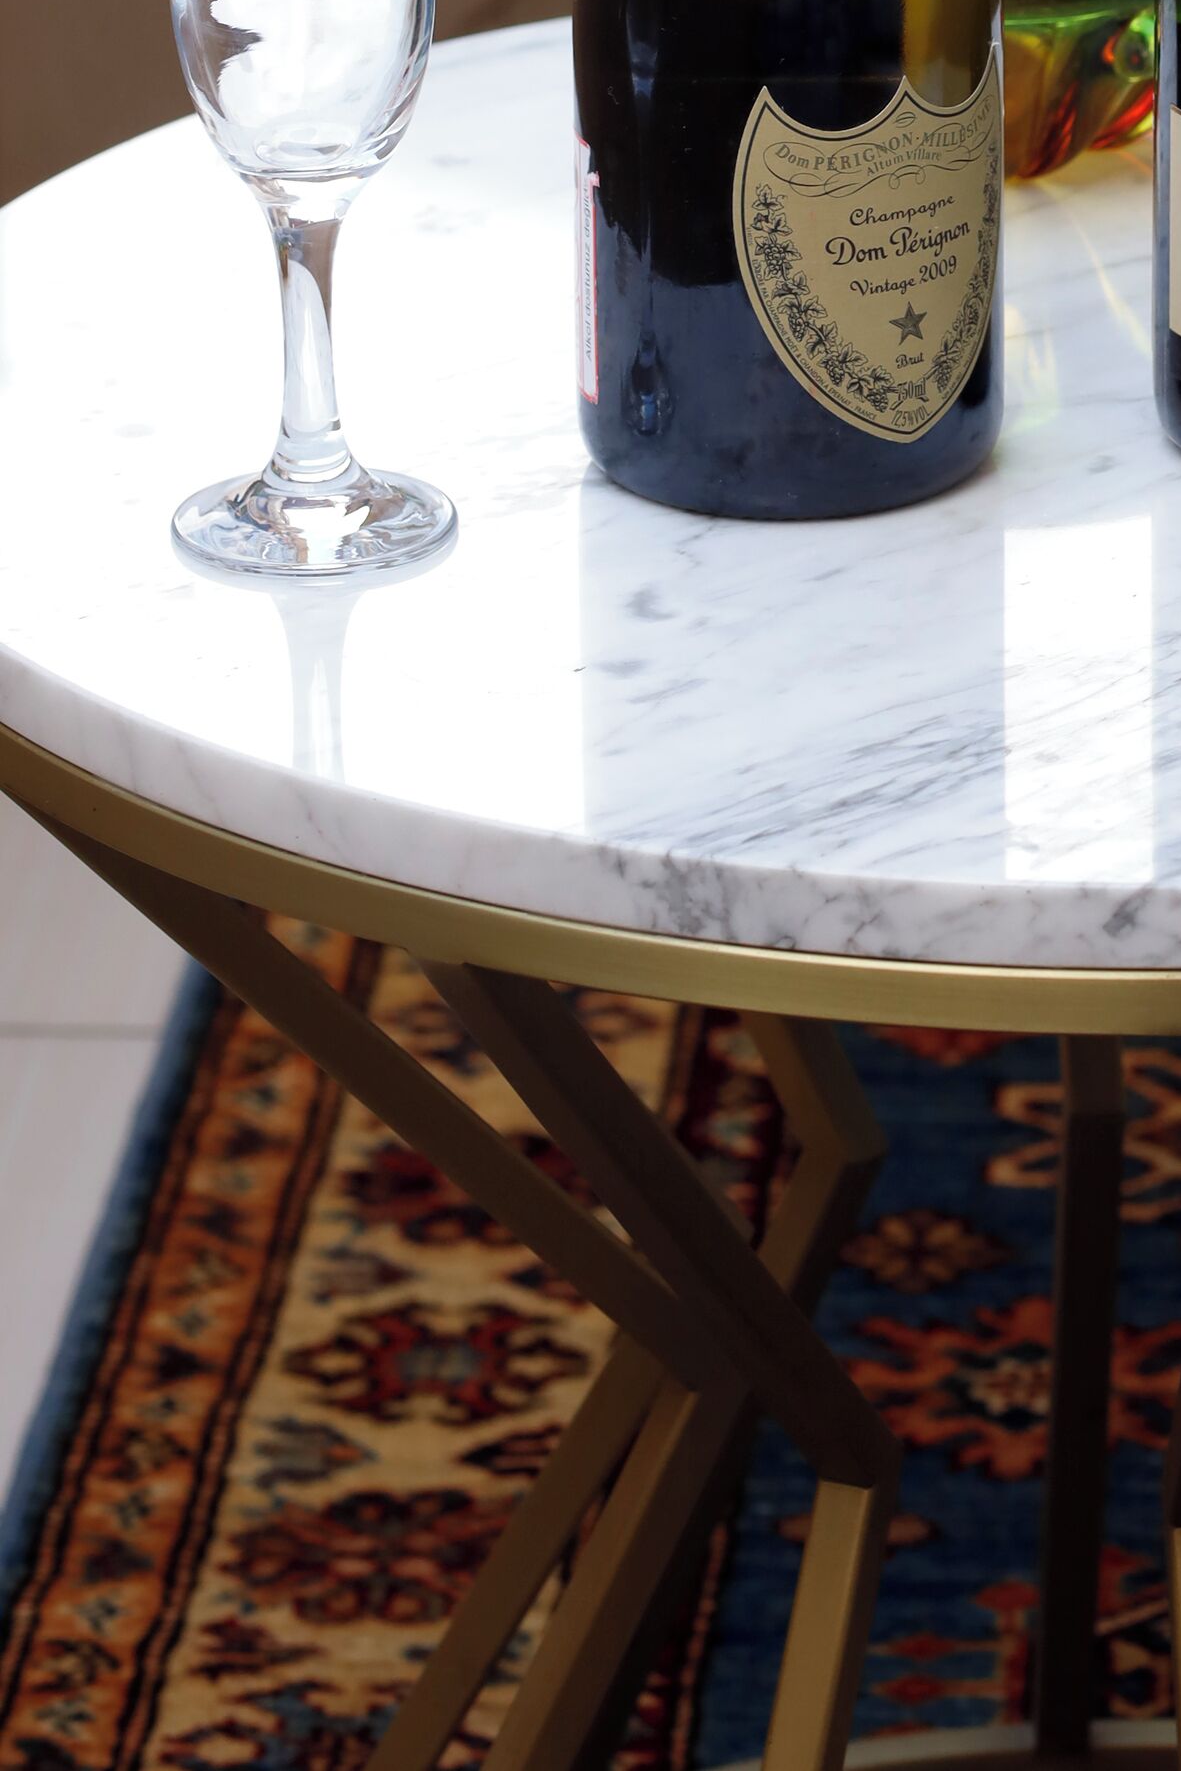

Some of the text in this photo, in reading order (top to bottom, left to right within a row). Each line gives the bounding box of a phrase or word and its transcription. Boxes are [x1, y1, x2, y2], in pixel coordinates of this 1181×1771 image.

[774, 143, 811, 169] Dom
[849, 195, 956, 227] Champagne
[825, 221, 970, 266] Dom Pérignon
[850, 255, 957, 296] Vintage 2009
[895, 352, 925, 369] Brut
